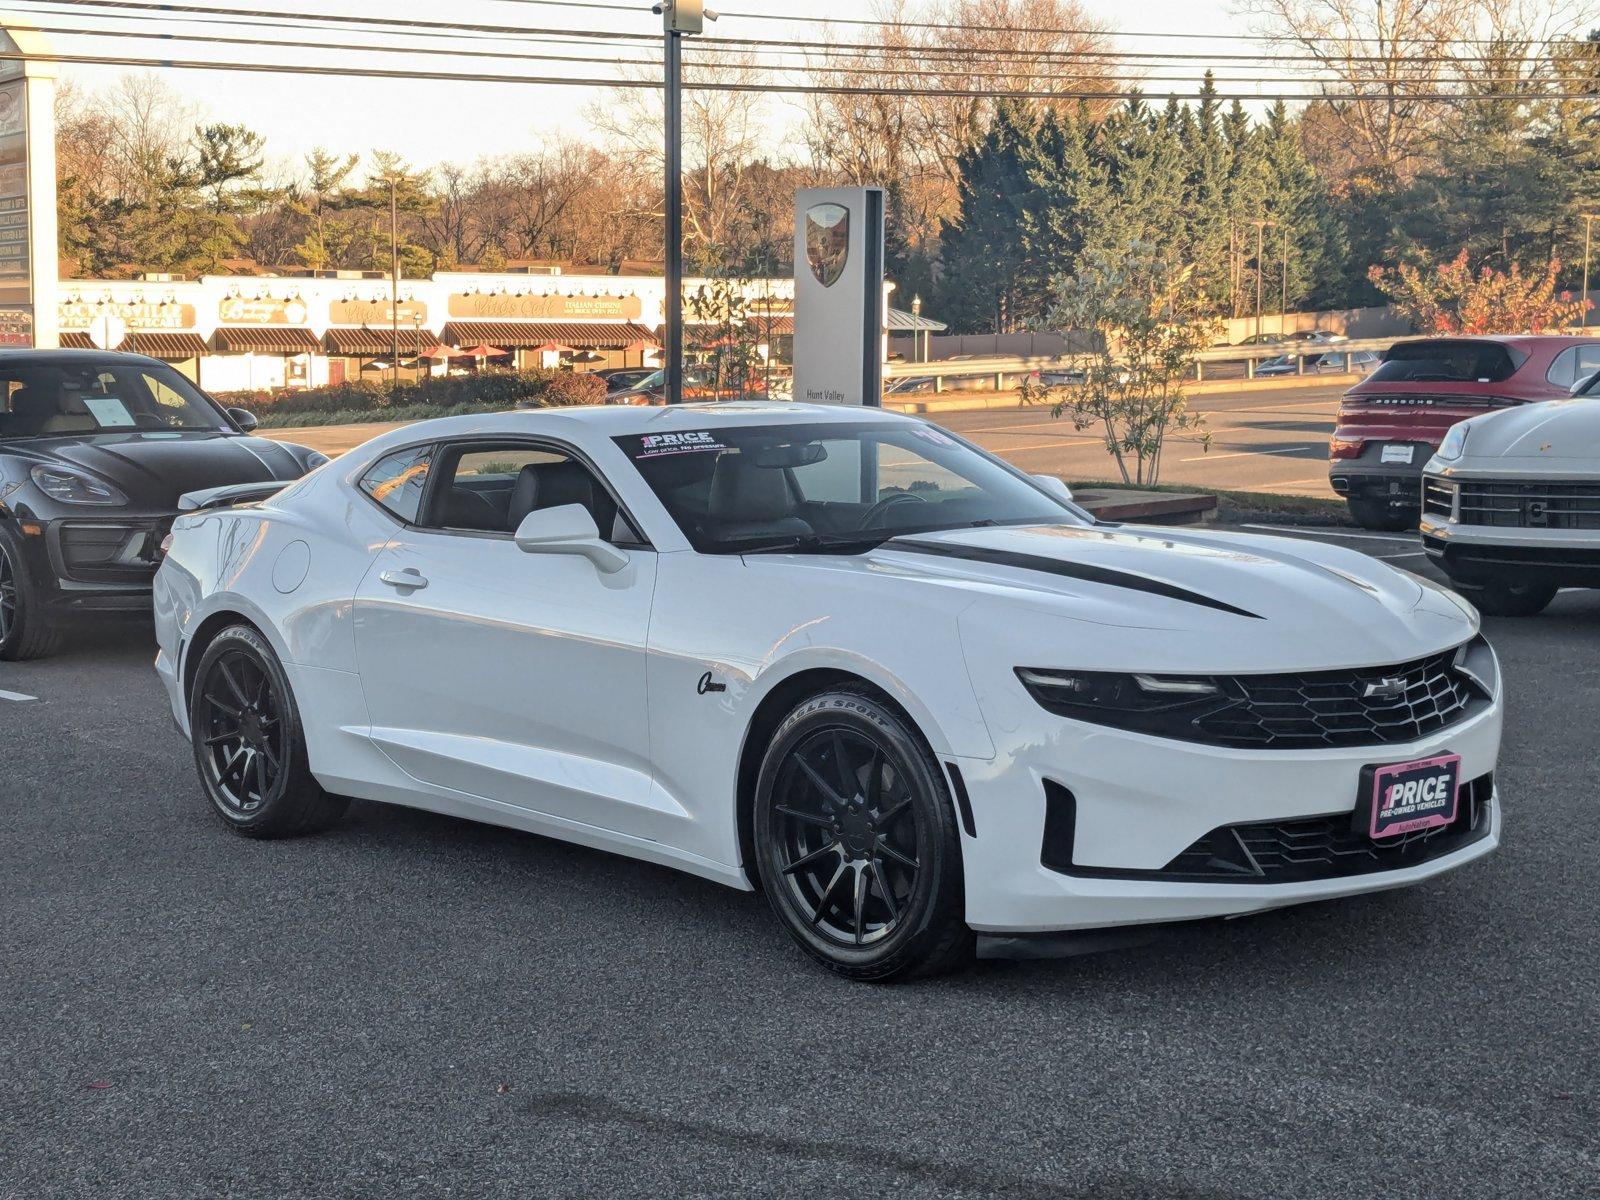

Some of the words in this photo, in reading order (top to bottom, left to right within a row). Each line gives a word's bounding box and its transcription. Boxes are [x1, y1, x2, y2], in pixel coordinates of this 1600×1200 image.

[806, 389, 823, 400] Hunt
[824, 390, 845, 403] Valley
[232, 631, 262, 649] SPORT
[833, 699, 890, 728] SPORT
[1382, 774, 1451, 810] 1PRICE
[1380, 805, 1416, 818] PRE-OWNED
[1416, 799, 1446, 810] VEHICLES
